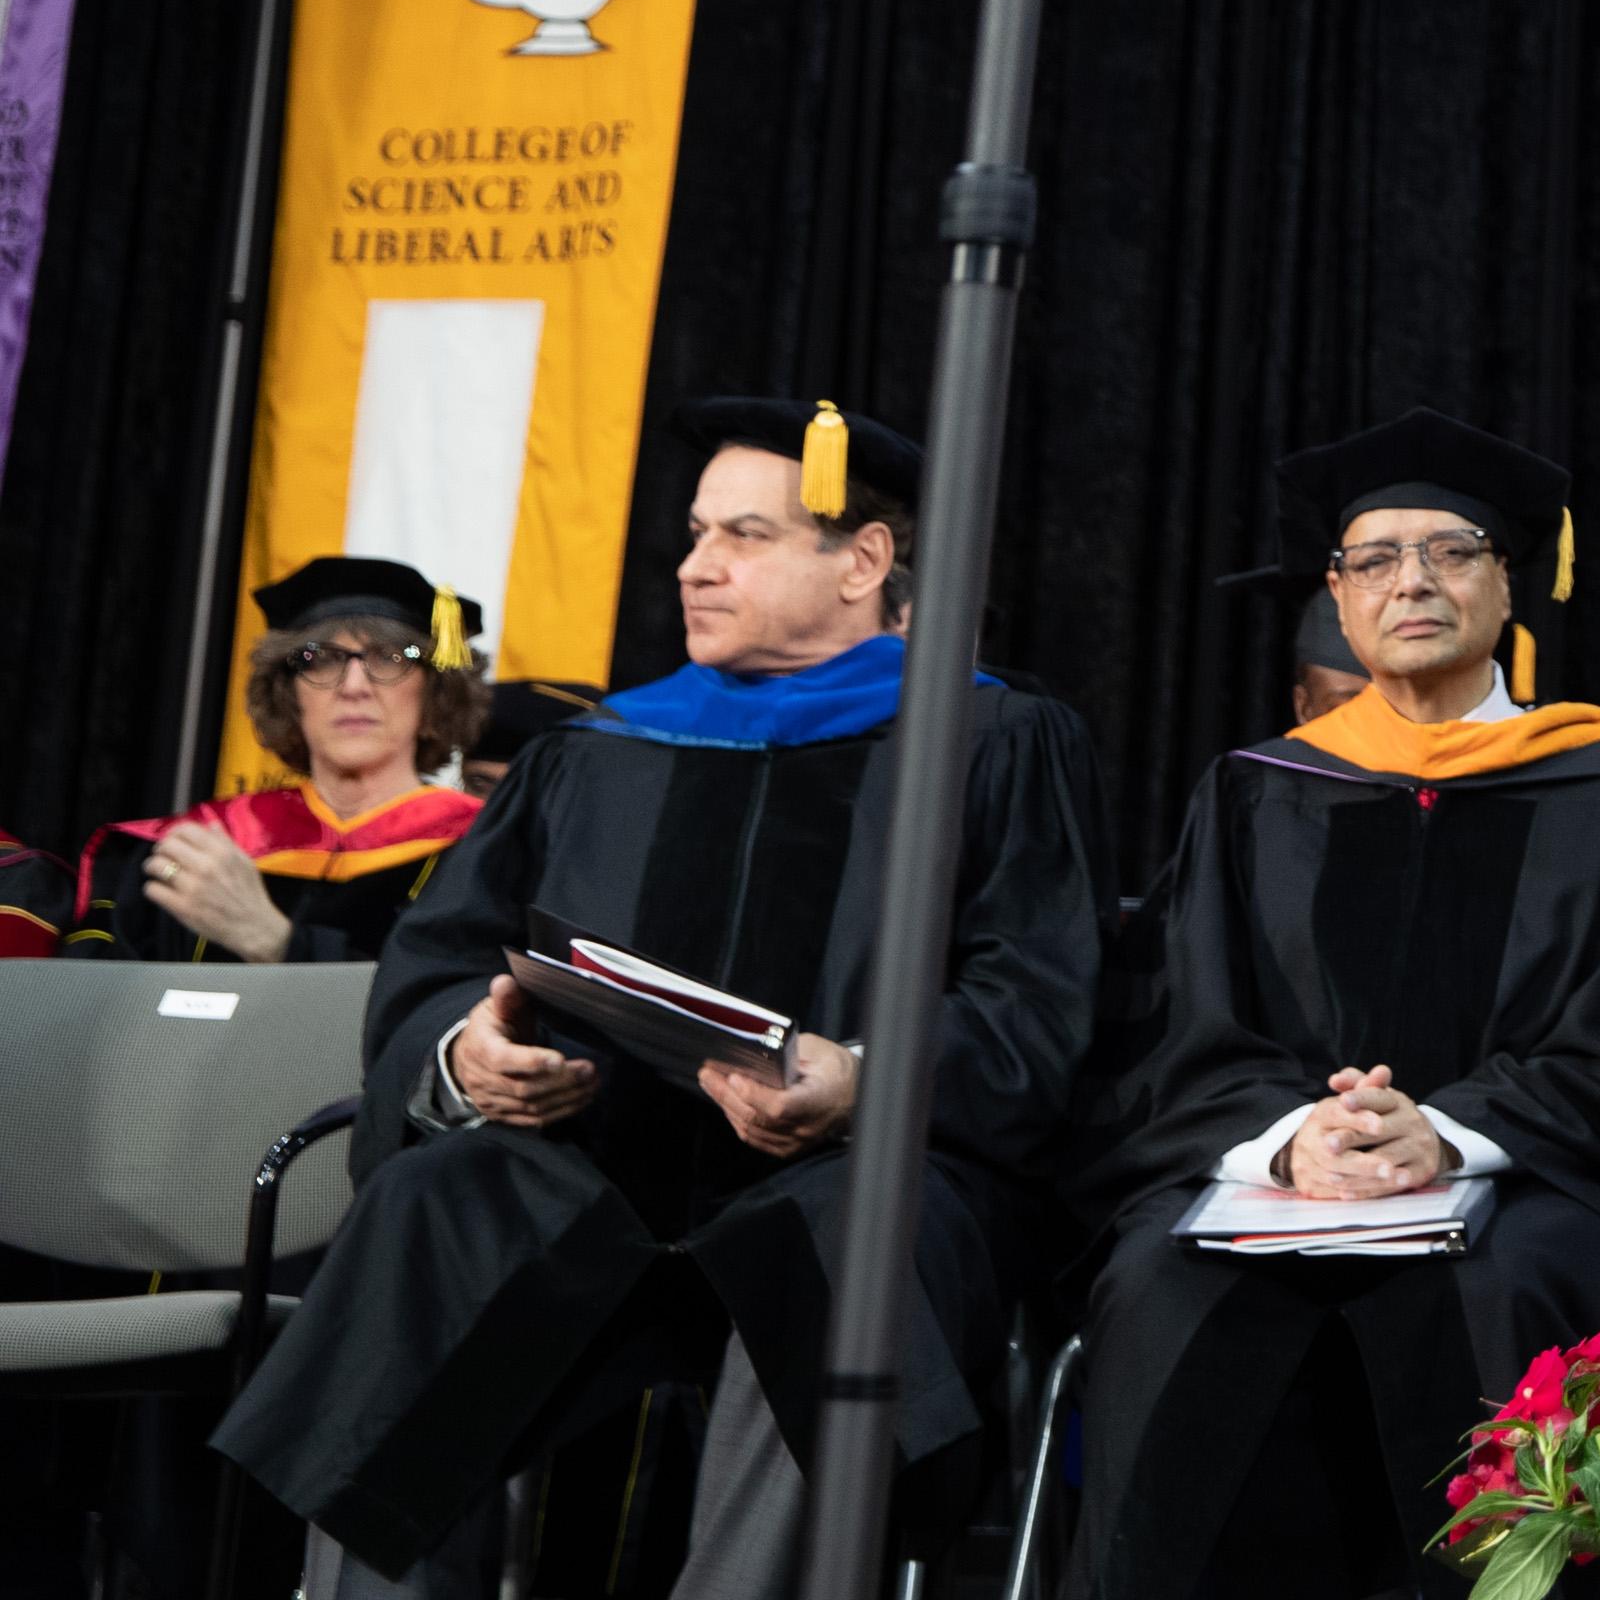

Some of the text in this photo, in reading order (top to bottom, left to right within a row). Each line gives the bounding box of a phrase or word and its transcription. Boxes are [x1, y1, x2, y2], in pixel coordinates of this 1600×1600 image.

[378, 119, 634, 167] COLLEGE OF
[342, 169, 623, 216] SCIENCE AND
[328, 218, 618, 267] LIBERAL ARTS
